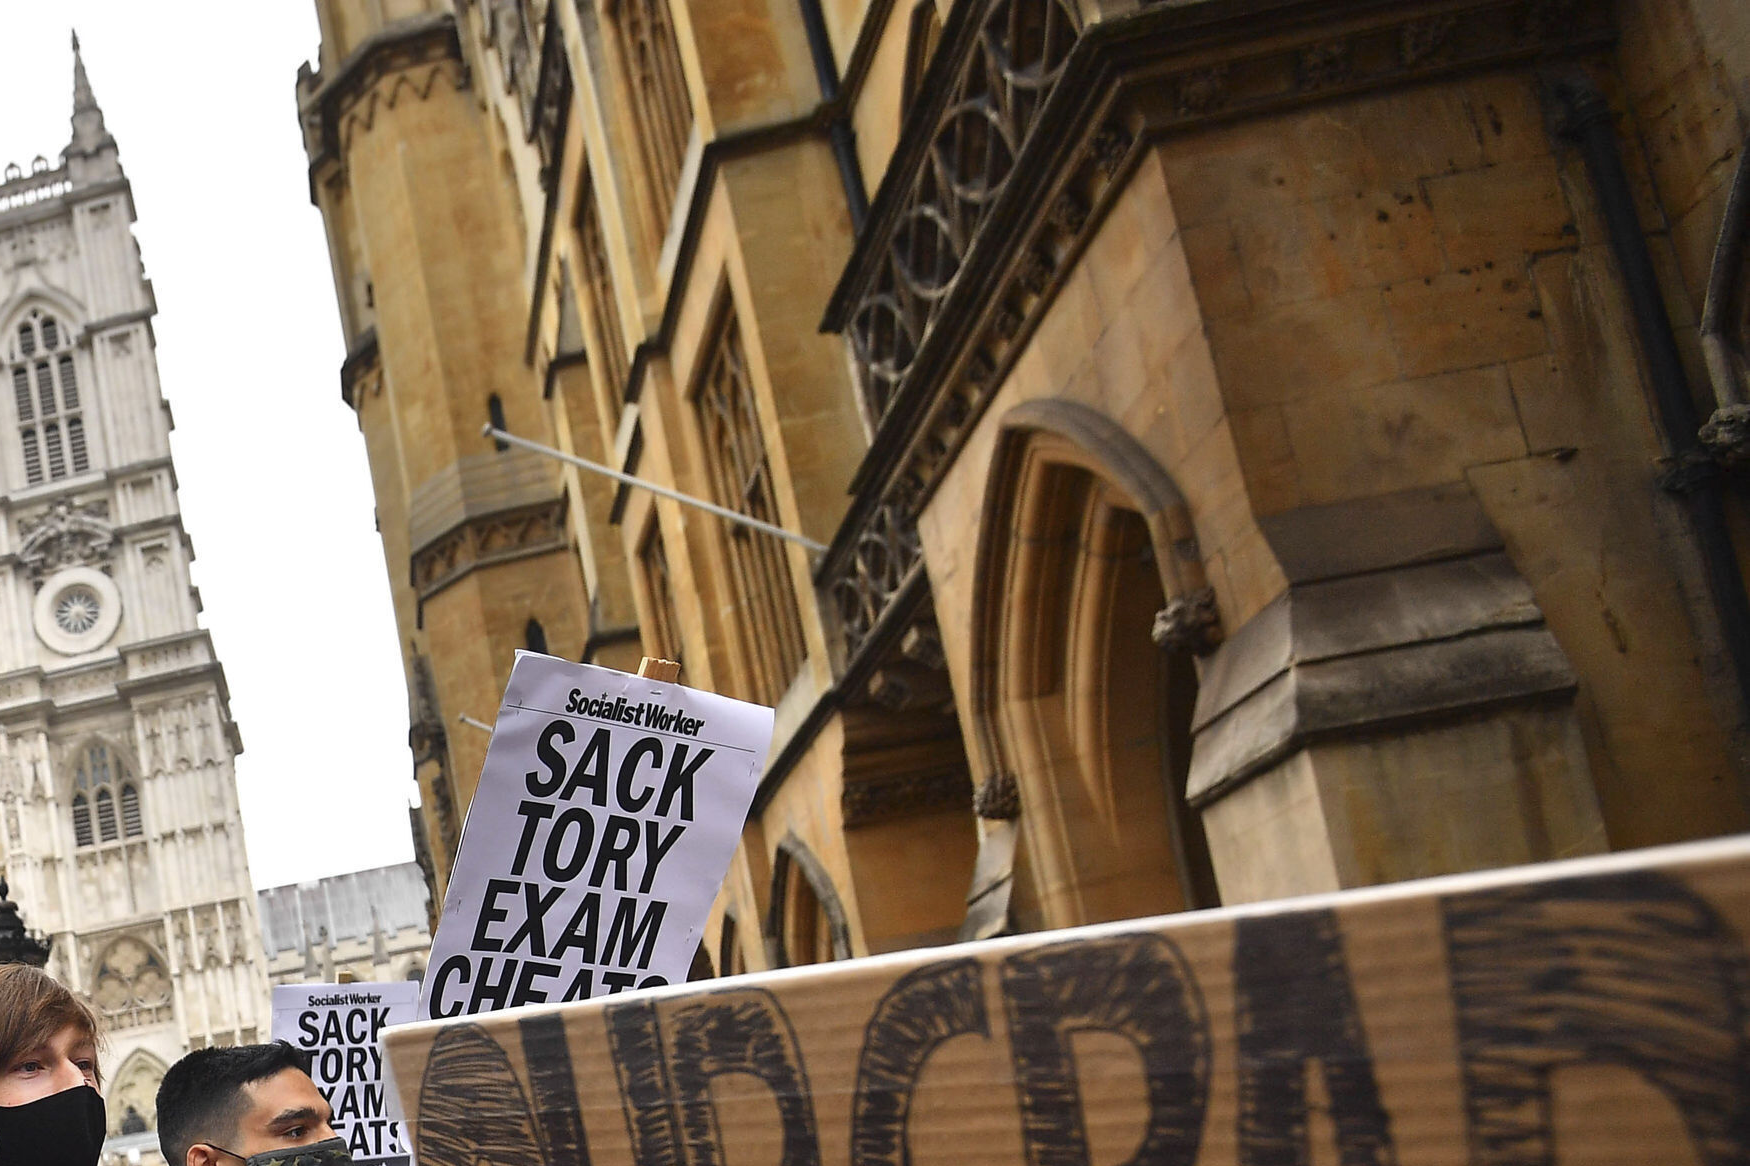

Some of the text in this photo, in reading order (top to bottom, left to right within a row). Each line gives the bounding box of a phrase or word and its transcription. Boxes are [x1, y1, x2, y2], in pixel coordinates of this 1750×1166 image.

[565, 687, 705, 738] Socialist Worker
[525, 719, 715, 821] SACK
[510, 801, 686, 894] TORY
[470, 879, 668, 970] EXAM
[298, 1007, 391, 1047] SACK
